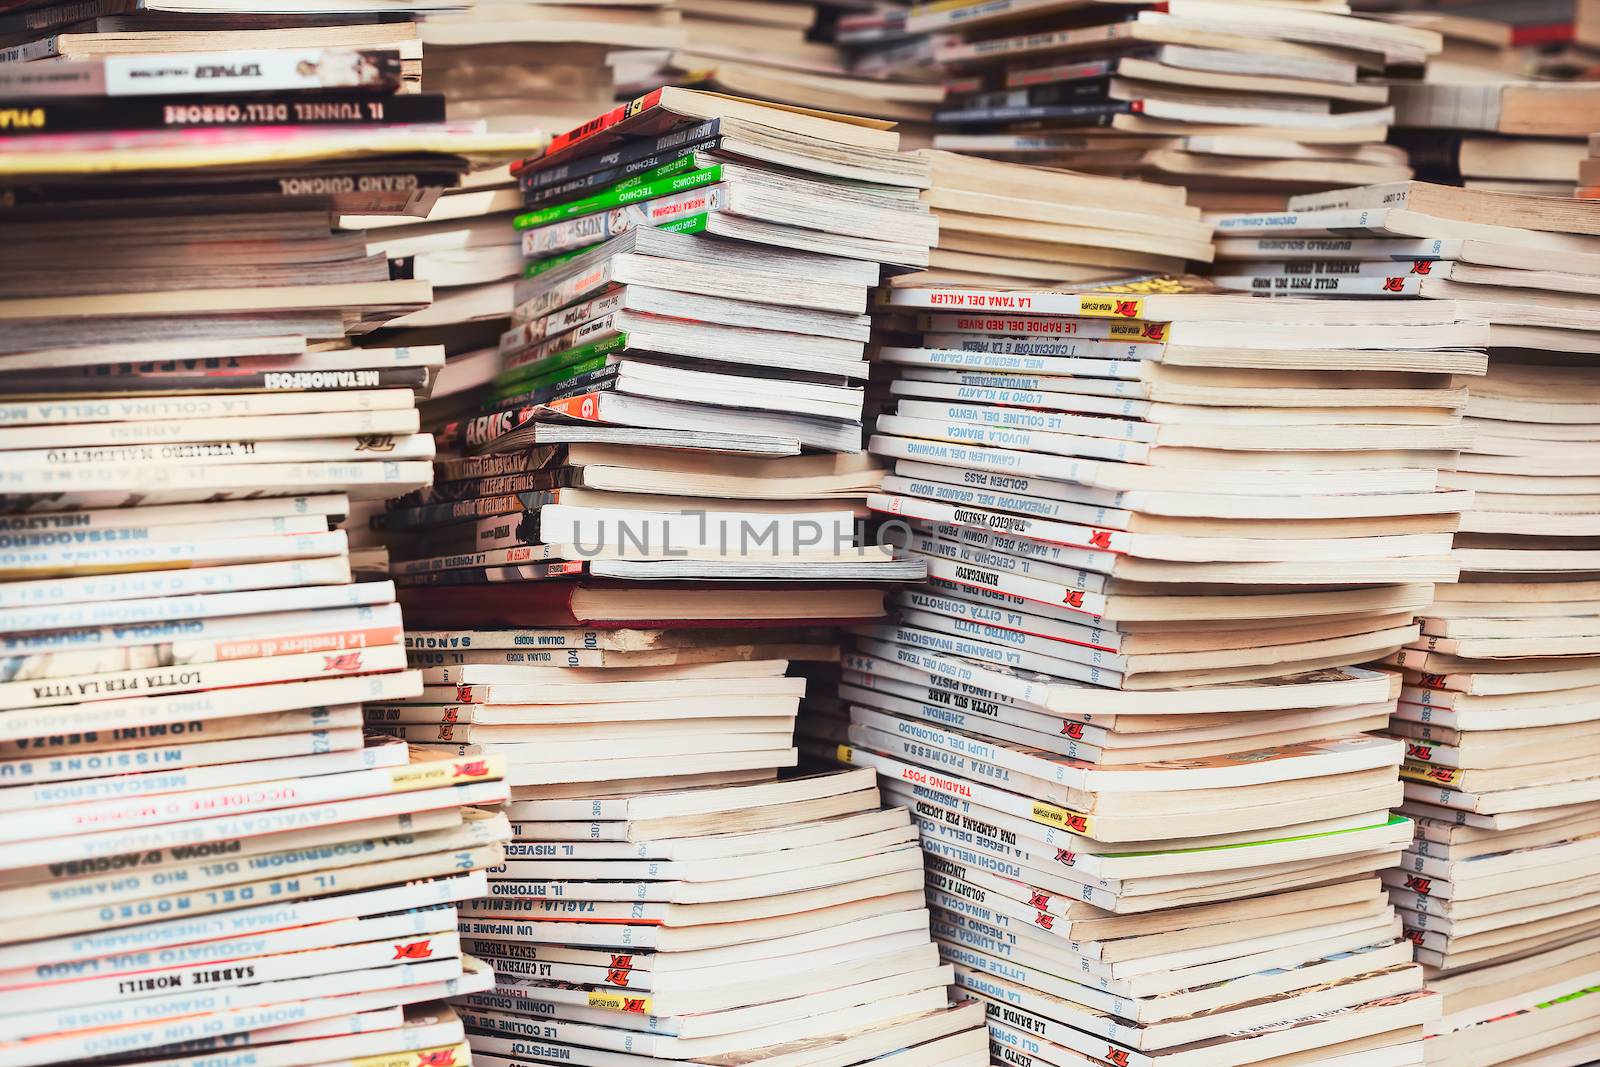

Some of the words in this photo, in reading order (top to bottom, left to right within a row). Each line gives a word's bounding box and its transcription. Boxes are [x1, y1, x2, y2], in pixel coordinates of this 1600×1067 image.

[164, 104, 287, 123] DELL'ORRORE
[294, 104, 361, 119] TUNNEL
[367, 103, 383, 118] IL
[700, 139, 716, 150] STAR
[626, 157, 658, 173] TECHNO
[657, 162, 675, 176] COMICS
[675, 158, 687, 168] STAR
[358, 175, 417, 190] GRAND
[673, 175, 696, 188] COMICS
[696, 171, 712, 182] STAR
[279, 177, 353, 195] GUIGNOL
[619, 187, 652, 201] TECHNO
[575, 216, 602, 237] NUTS
[679, 218, 697, 230] STAR
[1258, 240, 1305, 250] SOLDIERS
[1308, 241, 1352, 250] BUFFALO
[1409, 261, 1432, 275] TEX
[1291, 278, 1312, 289] PISTE
[1314, 278, 1339, 289] SULLE
[1383, 277, 1405, 292] TEX
[930, 293, 964, 305] KILLER
[967, 295, 985, 306] DEL
[988, 296, 1015, 307] TANA
[1018, 298, 1031, 308] LA
[986, 320, 1004, 331] RED
[1007, 320, 1024, 332] DEL
[1027, 321, 1061, 333] RAPIDE
[1014, 342, 1068, 355] CACCIATORI
[590, 368, 606, 379] COMICS
[605, 364, 615, 375] STAR
[264, 371, 379, 387] METAMORFOSI
[556, 377, 578, 390] TECHNO
[948, 407, 978, 419] VENTO
[980, 410, 1000, 423] DEL
[1002, 412, 1044, 427] COLLINE
[466, 411, 514, 444] ARMS
[1048, 418, 1061, 428] LE
[947, 426, 984, 440] BIANCA
[988, 431, 1030, 445] NUVOLA
[964, 472, 988, 484] PASS
[990, 475, 1028, 490] GOLDEN
[910, 483, 934, 497] NORD
[936, 487, 973, 502] GRANDE
[976, 493, 995, 506] DEL
[997, 497, 1052, 515] PREDATORI
[476, 555, 485, 563] LA
[955, 566, 999, 586] RINNEGATO!
[911, 594, 966, 614] CORROTTA
[1007, 613, 1022, 626] LA
[954, 620, 980, 635] TUTTI
[984, 626, 1026, 644] CONTRO
[405, 637, 470, 648] SANGUE
[514, 636, 534, 645] RODEO
[537, 636, 565, 646] COLLANA
[896, 630, 953, 650] INVASIONE
[451, 654, 464, 663] IL
[506, 653, 524, 662] RODEO
[527, 652, 551, 662] COLLANA
[898, 650, 920, 667] TEXAS
[956, 642, 1003, 662] GRANDE
[1006, 652, 1021, 664] LA
[937, 663, 957, 676] EROI
[958, 667, 972, 680] GLI
[77, 681, 99, 693] LA
[106, 678, 138, 690] PER
[145, 672, 201, 687] LOTTA
[1418, 673, 1447, 689] TEX
[33, 683, 72, 699] VITA
[928, 688, 950, 705] MARE
[971, 698, 998, 717] LOTTA
[113, 721, 203, 739] UOMINI
[898, 722, 945, 745] COLORADO
[15, 731, 98, 749] SENZA
[946, 737, 965, 751] DEL
[903, 742, 965, 770] PROMESSA
[968, 743, 988, 758] LUPI
[1406, 744, 1432, 760] TEX
[49, 749, 181, 771] MISSIONE
[901, 768, 927, 784] POST
[970, 760, 1010, 781] TERRA
[1427, 767, 1455, 783] TEX
[929, 775, 972, 797] TRADING
[912, 784, 959, 809] DISERTORE
[592, 800, 601, 816] 369
[916, 801, 944, 819] LUCERO
[944, 811, 960, 825] PER
[591, 822, 600, 838] 307
[961, 816, 998, 839] CAMPANA
[999, 830, 1017, 846] UNA
[172, 839, 241, 860] PROVA
[562, 845, 573, 855] IL
[943, 845, 977, 864] NELLA
[48, 849, 161, 877] D'ACCUSA
[978, 855, 1020, 877] FUOCHI
[263, 877, 300, 897] RE
[313, 874, 336, 888] IL
[1404, 874, 1432, 895] TEX
[205, 886, 253, 905] DEL
[492, 885, 546, 895] RITORNO
[552, 886, 563, 895] IL
[99, 896, 190, 922] RODEO
[471, 900, 532, 911] DUEMILA
[539, 900, 595, 912] TAGLIA:
[942, 897, 990, 920] MINACCIA
[473, 923, 513, 935] INFAME
[515, 925, 532, 936] UN
[968, 920, 1003, 939] REGNO
[474, 941, 508, 956] TREGUA
[959, 930, 995, 952] LUNGA
[392, 940, 432, 960] TEX
[509, 944, 536, 958] SENZA
[497, 959, 537, 975] CAVERNA
[608, 954, 633, 969] TEX
[192, 966, 255, 985] SABBIE
[539, 964, 551, 976] LA
[990, 962, 1026, 981] LITTLE
[118, 972, 181, 994] MOBILI
[604, 969, 629, 987] TEX
[967, 977, 1005, 998] MORTE
[466, 995, 512, 1008] CRUDELI
[516, 1000, 555, 1014] UOMINI
[620, 997, 646, 1014] TEX
[479, 1018, 495, 1028] DEI
[1003, 1006, 1032, 1029] BANDA
[499, 1020, 540, 1035] COLLINE
[543, 1028, 557, 1038] LE
[511, 1043, 570, 1059] MEFISTO!
[1021, 1039, 1039, 1053] GLI
